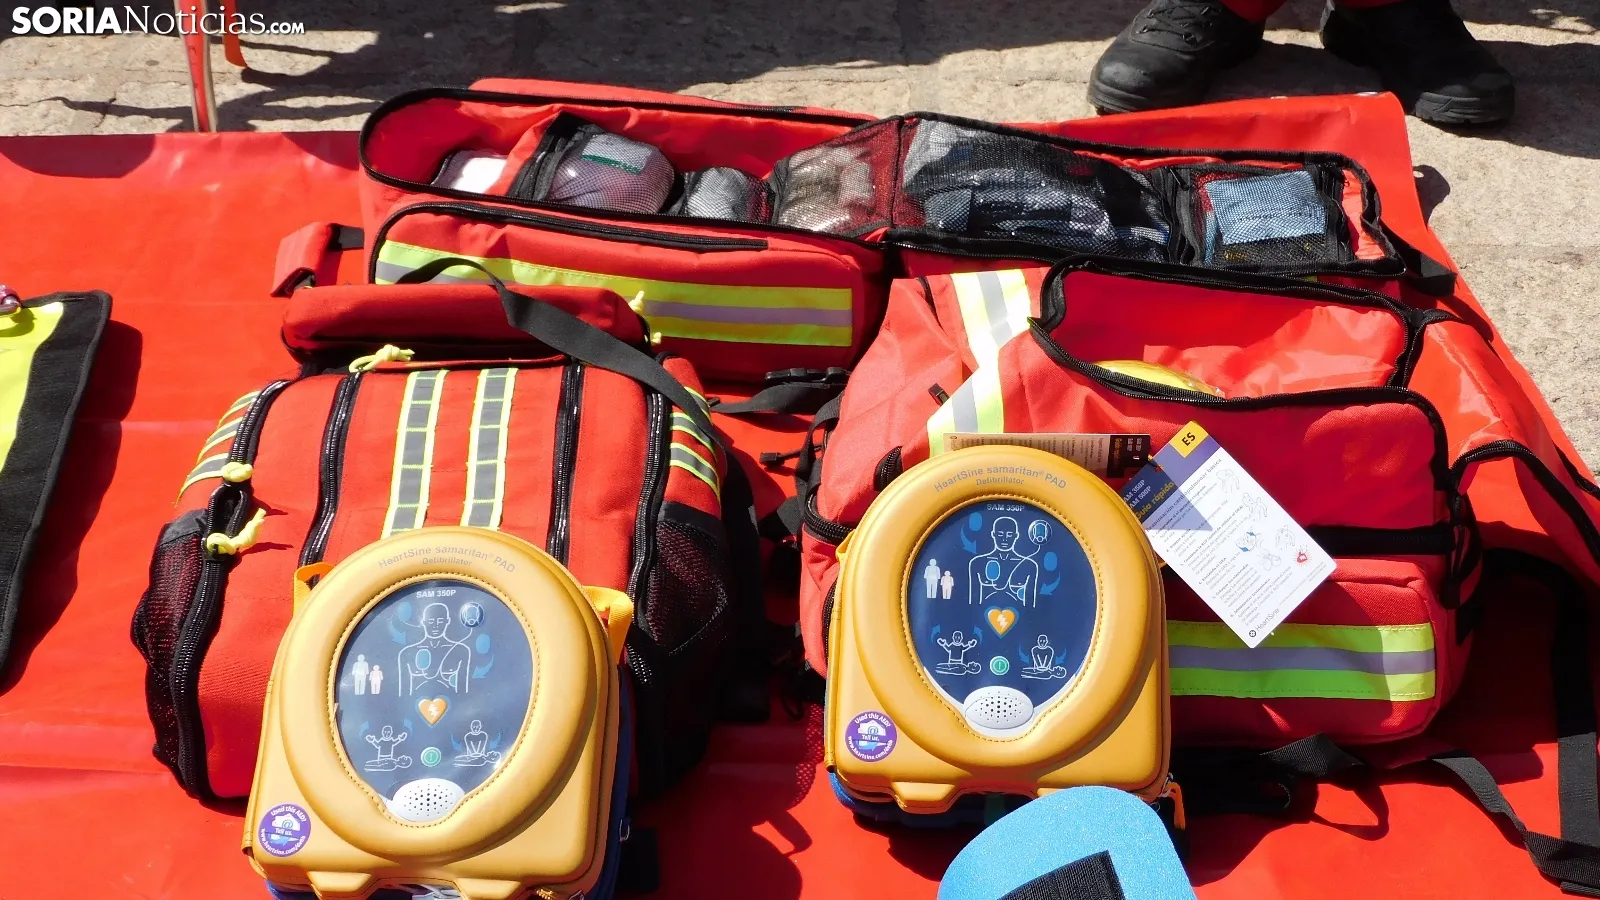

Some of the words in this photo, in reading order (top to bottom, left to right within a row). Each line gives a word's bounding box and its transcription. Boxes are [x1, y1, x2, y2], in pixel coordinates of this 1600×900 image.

[1181, 431, 1196, 446] ES
[934, 468, 983, 492] HeartSine
[1045, 473, 1067, 489] PAD
[976, 476, 1025, 486] Defibrillator
[1149, 478, 1176, 505] rápida
[378, 545, 432, 569] HeartSine
[494, 556, 516, 573] PAD
[422, 557, 473, 567] Defibrillator
[416, 590, 435, 598] SAM
[436, 589, 456, 597] 350P
[854, 713, 868, 724] Used
